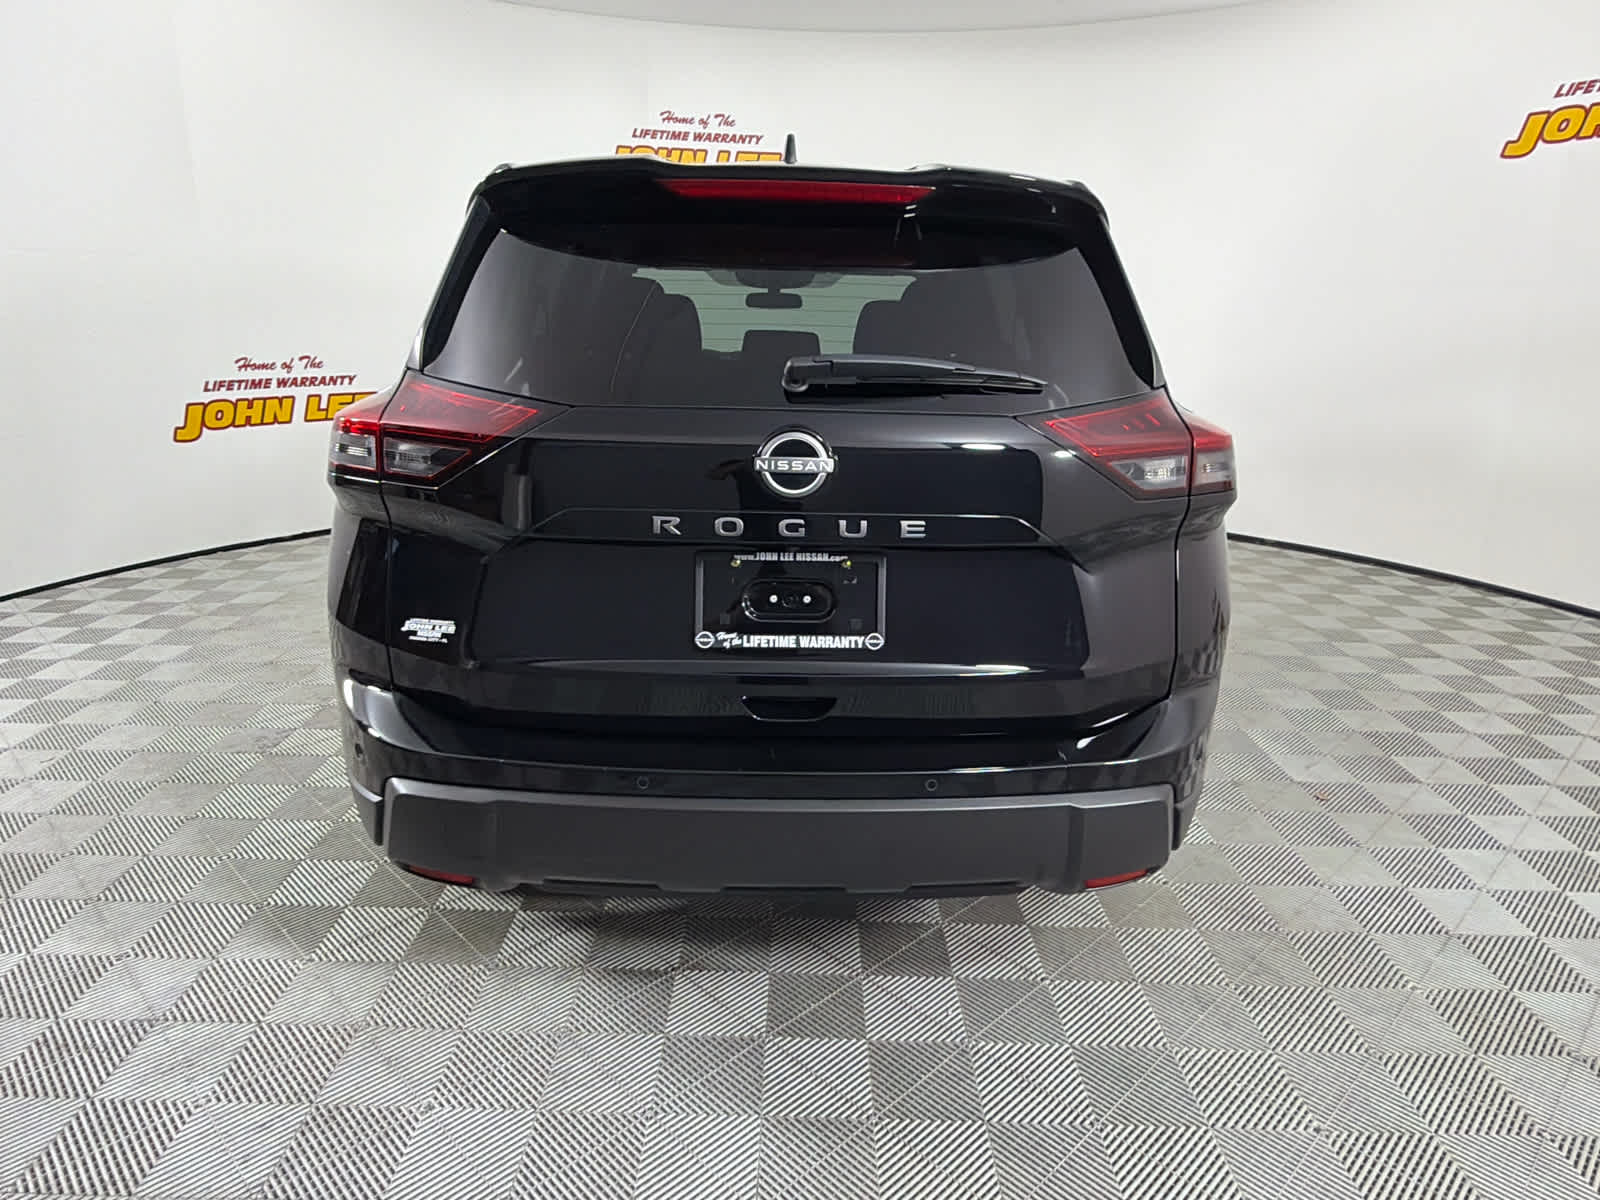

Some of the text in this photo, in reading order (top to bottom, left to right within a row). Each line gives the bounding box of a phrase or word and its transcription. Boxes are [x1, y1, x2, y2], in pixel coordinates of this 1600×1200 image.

[659, 110, 736, 129] Home of The
[632, 128, 764, 145] LIFETIME WARRANTY
[234, 355, 323, 374] Home of The
[203, 375, 357, 393] LIFETIME WARRANTY
[173, 395, 296, 443] JOHN
[755, 459, 833, 472] NISSAN
[651, 515, 927, 539] ROGUE
[780, 552, 795, 562] LEE
[743, 635, 798, 648] LIFETIME
[798, 636, 865, 649] WARRANTY
